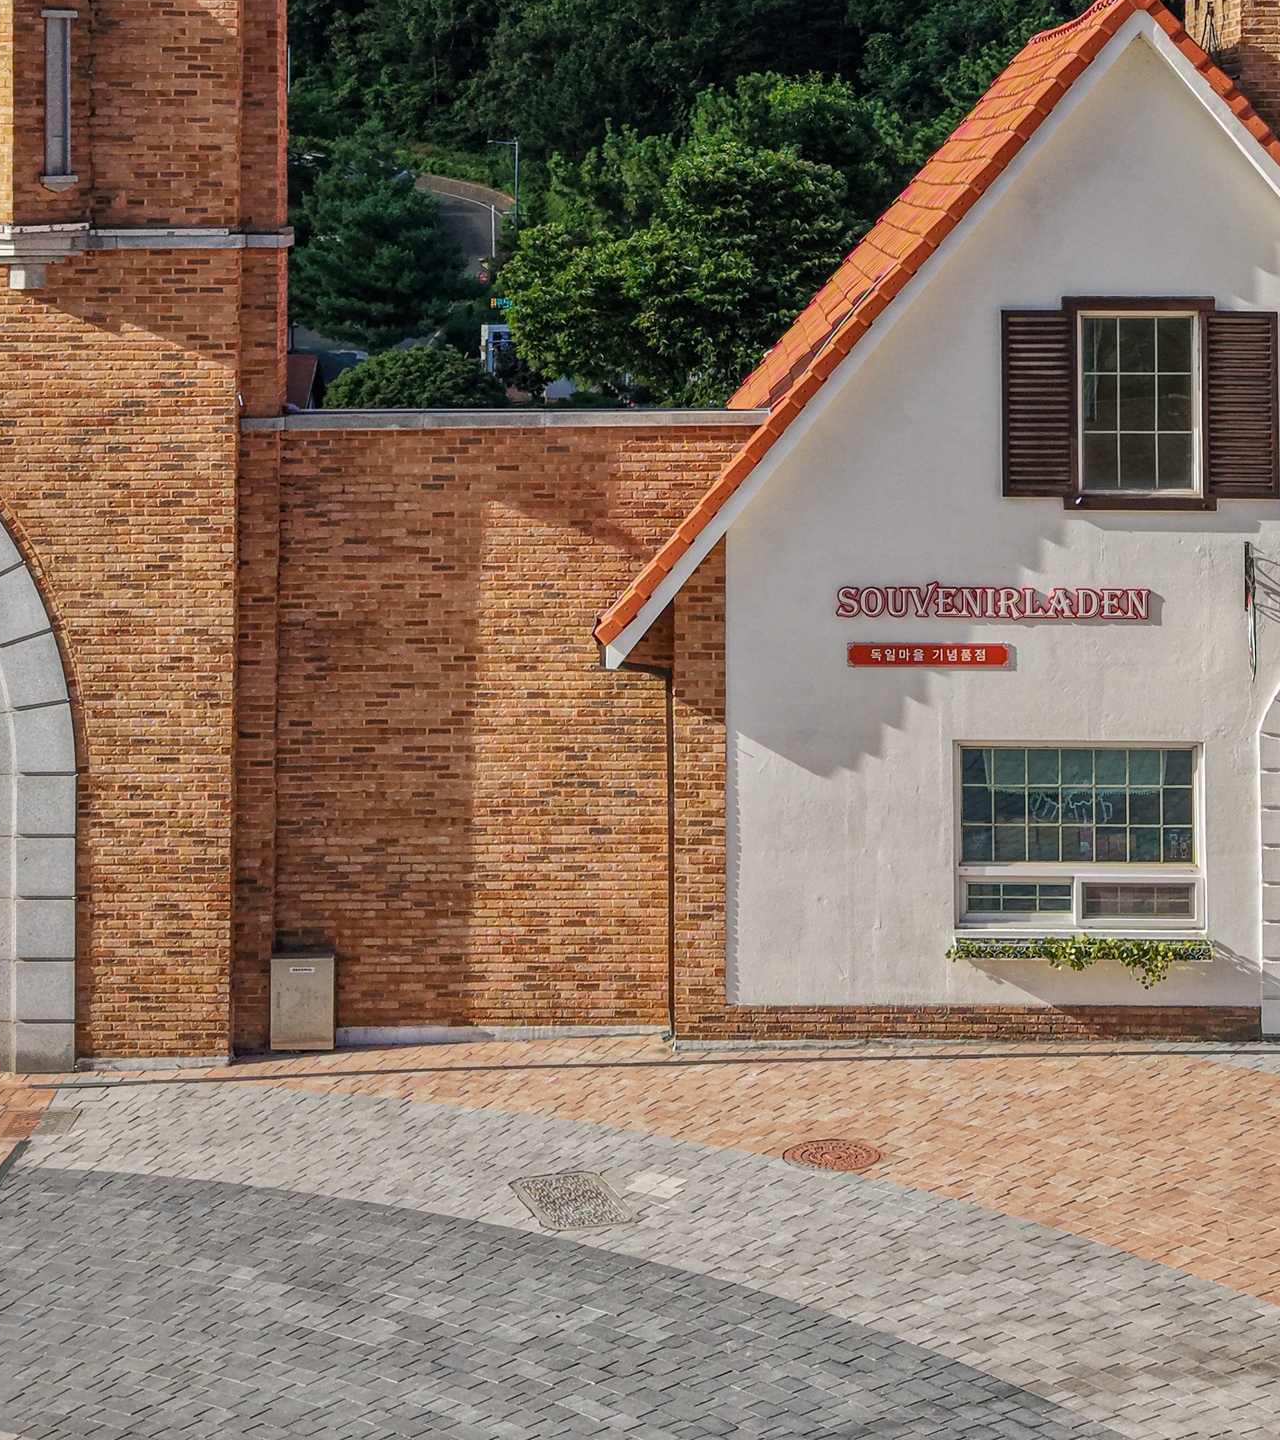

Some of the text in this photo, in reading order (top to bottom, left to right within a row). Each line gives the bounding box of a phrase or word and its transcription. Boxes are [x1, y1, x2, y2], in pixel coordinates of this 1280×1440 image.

[836, 581, 1151, 621] SOUVENIRLADEN
[869, 648, 988, 663] 독일마을 기념품점
